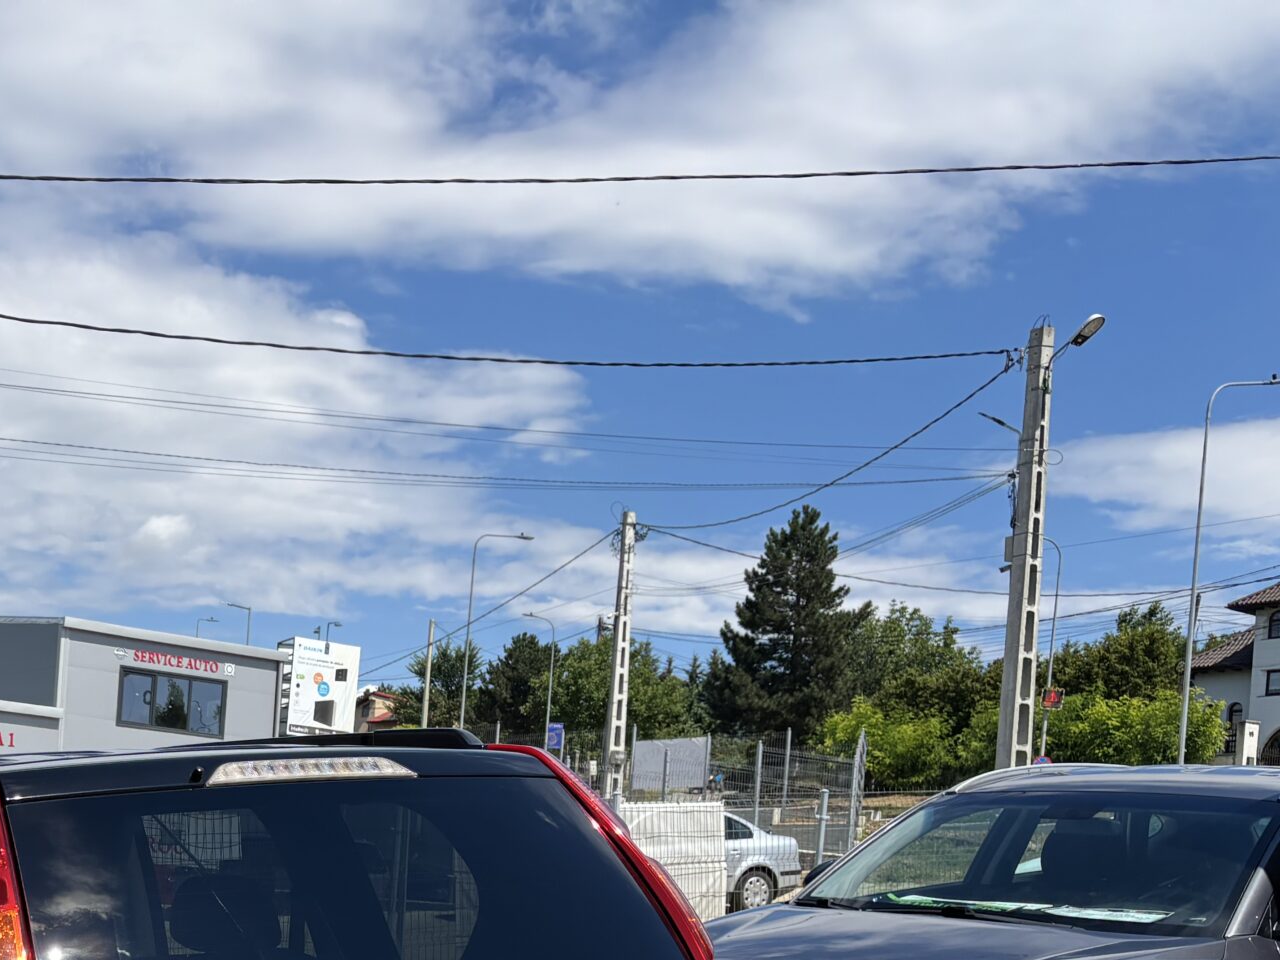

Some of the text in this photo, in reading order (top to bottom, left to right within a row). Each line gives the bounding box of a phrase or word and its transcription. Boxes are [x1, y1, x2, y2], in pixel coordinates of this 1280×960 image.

[133, 649, 219, 673] SERVICE AUTO
[7, 733, 15, 747] 1
